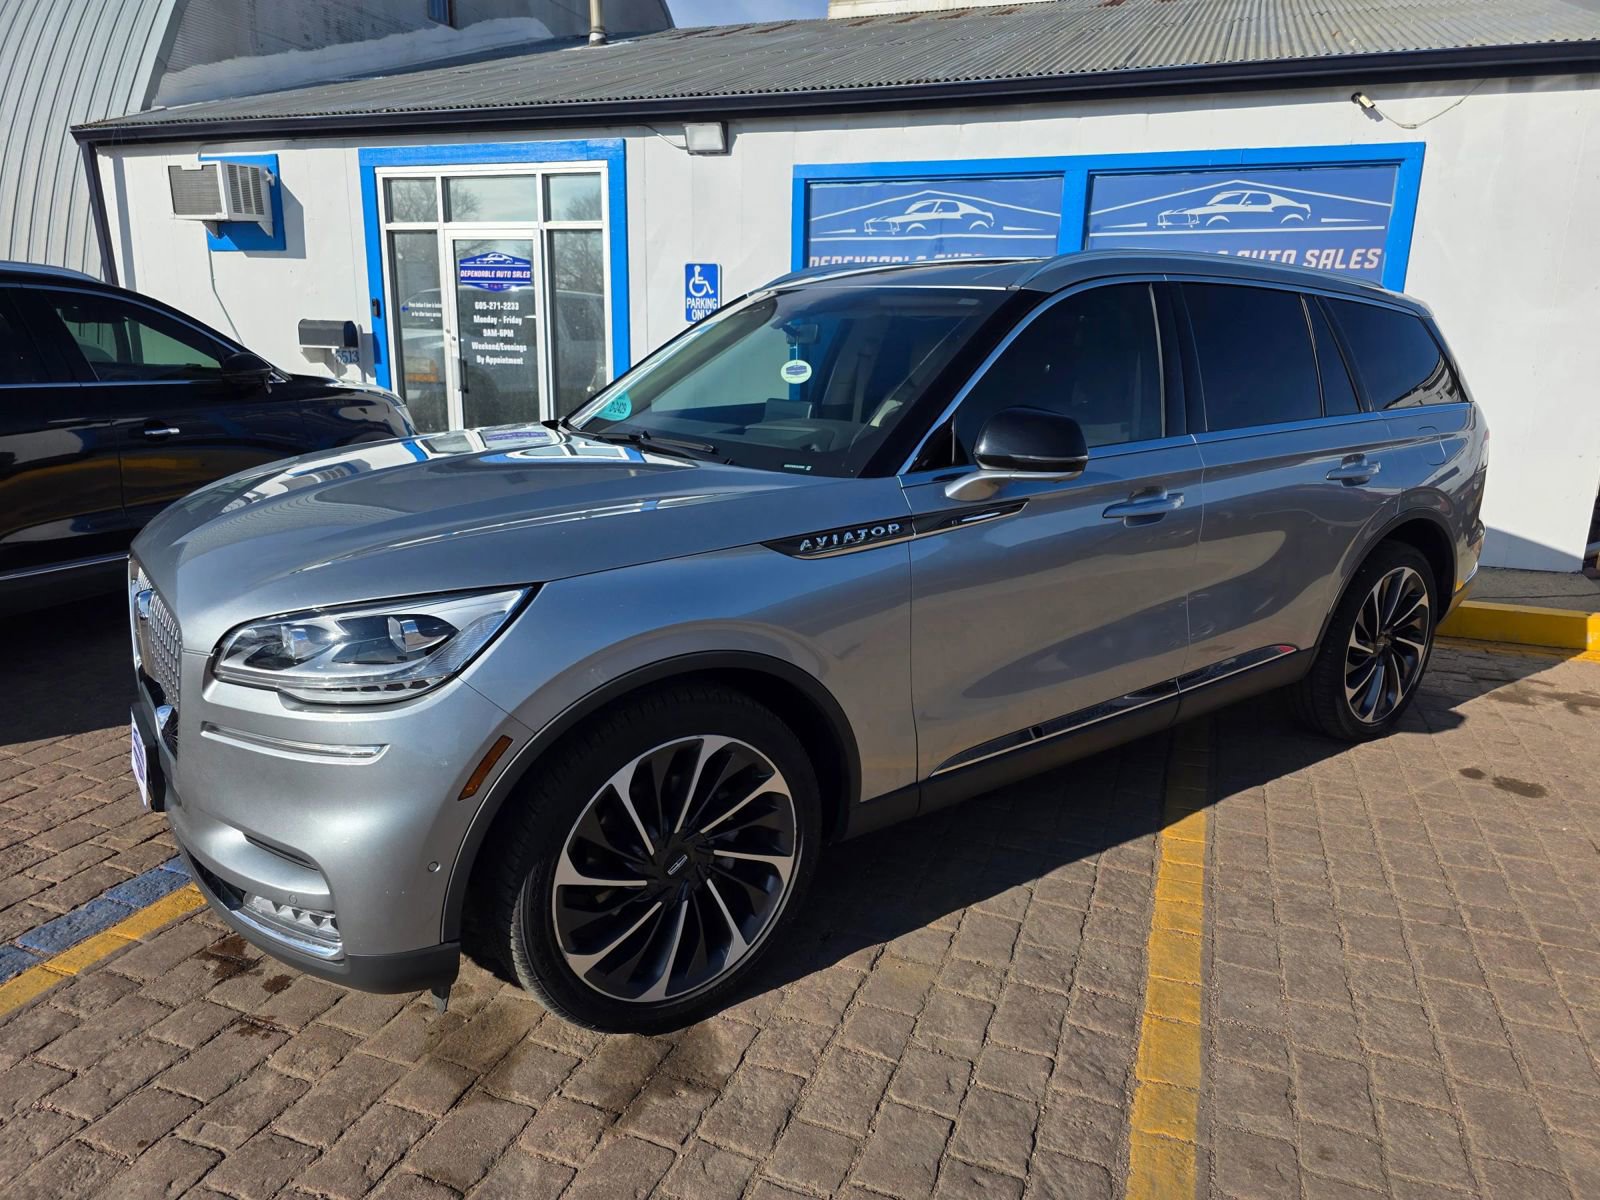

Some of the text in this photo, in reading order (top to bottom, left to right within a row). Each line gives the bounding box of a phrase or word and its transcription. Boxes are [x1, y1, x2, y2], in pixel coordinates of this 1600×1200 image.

[1302, 247, 1382, 268] SALES
[460, 270, 531, 279] DEPENDABLE AUTO SALES
[474, 301, 520, 310] 605-271-2233
[686, 297, 717, 309] PARKING
[473, 315, 498, 325] Monday
[503, 315, 523, 326] Friday
[471, 341, 527, 352] Weekend/Evenings
[476, 354, 524, 366] By Appointment
[800, 522, 901, 551] AVIATOR
